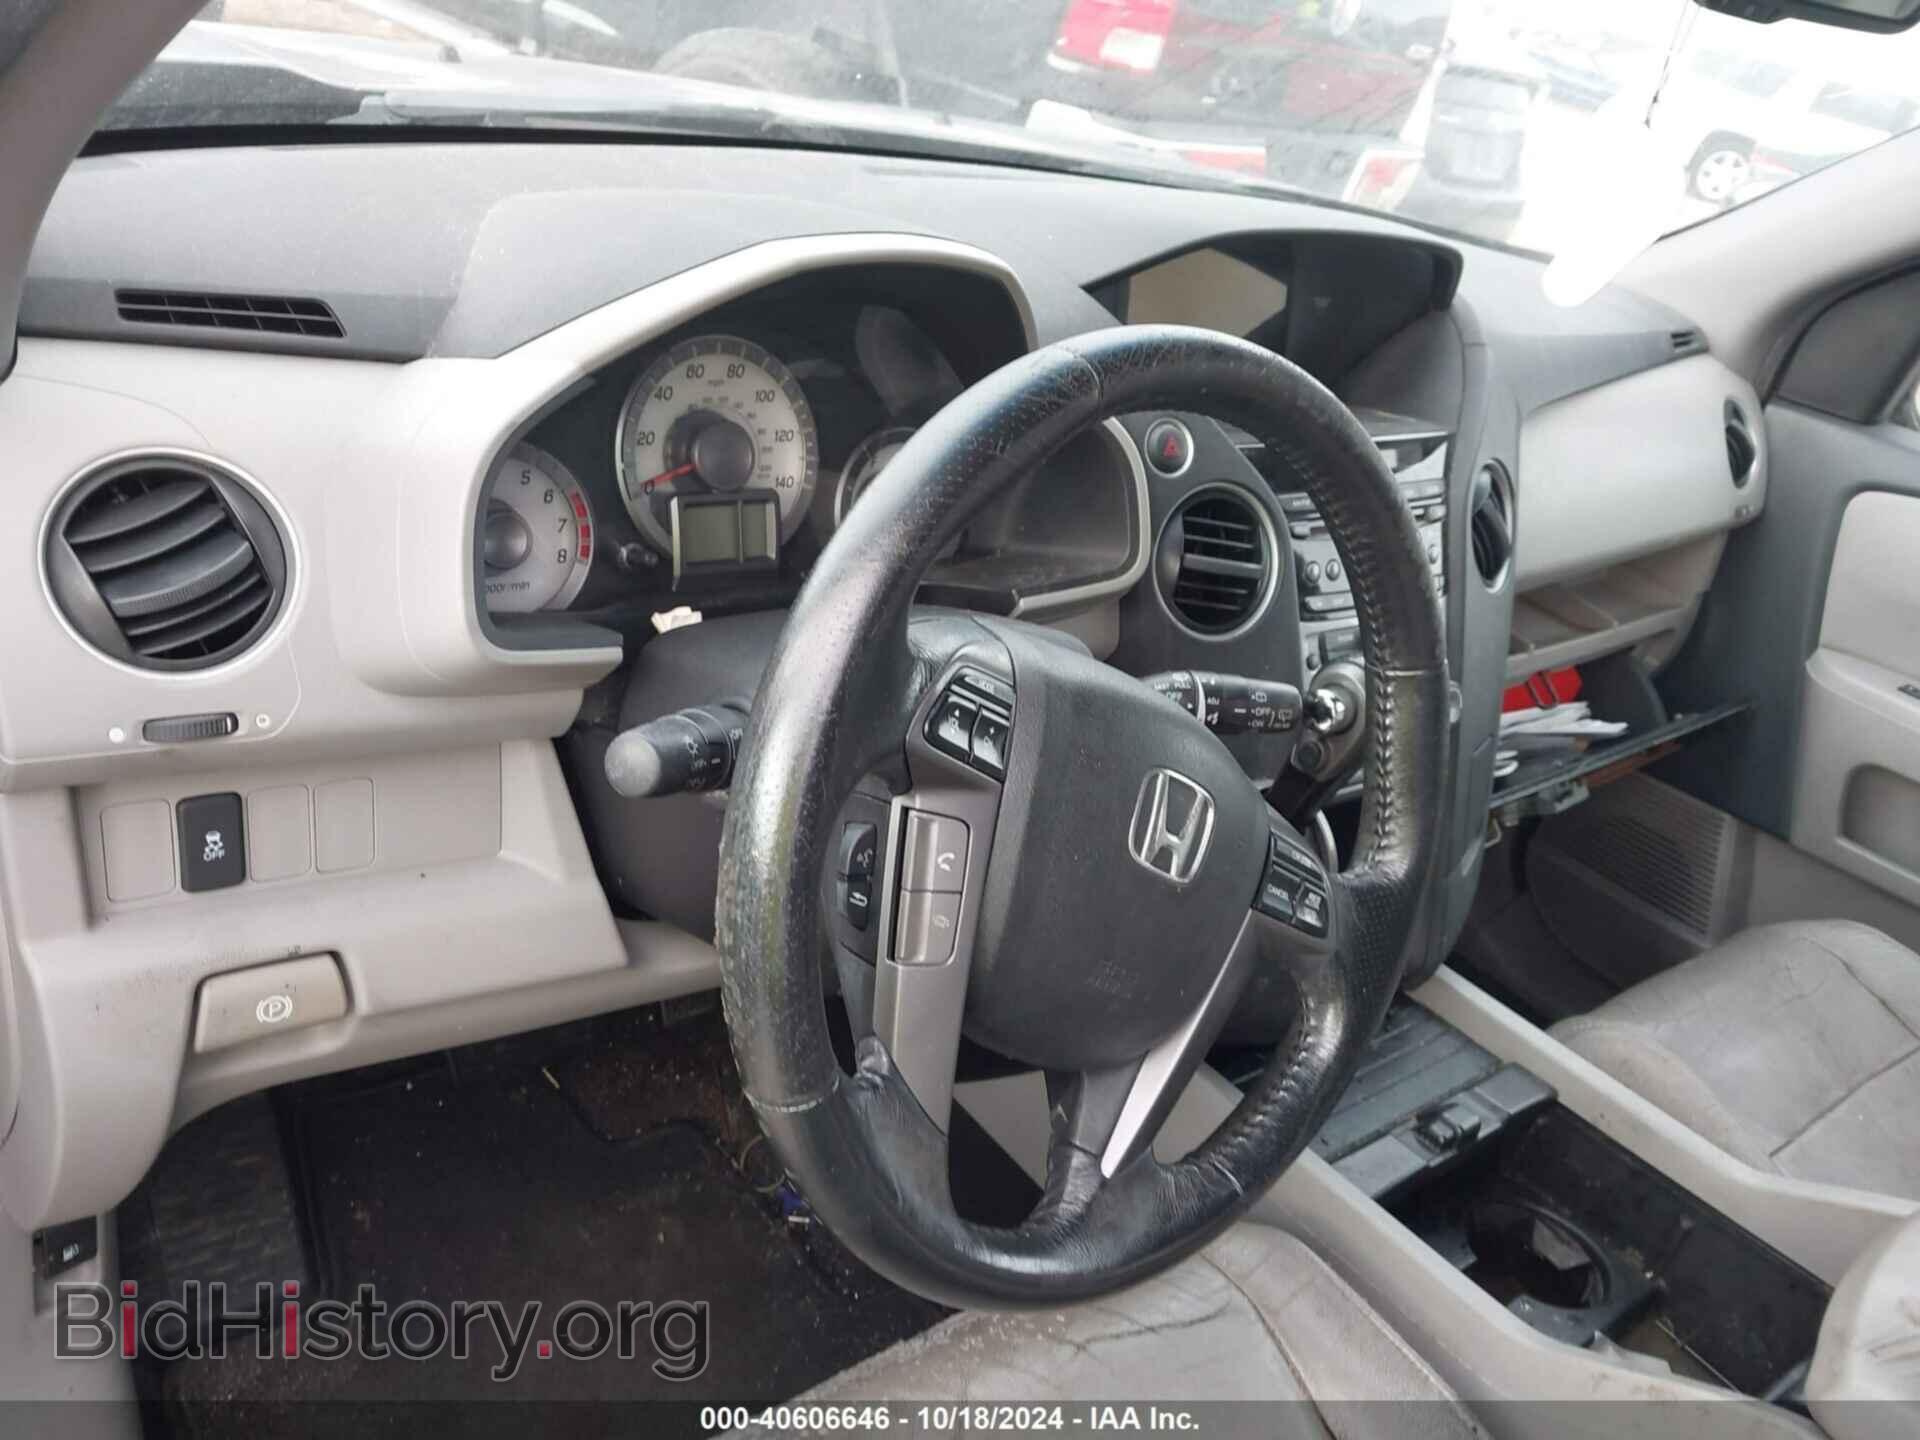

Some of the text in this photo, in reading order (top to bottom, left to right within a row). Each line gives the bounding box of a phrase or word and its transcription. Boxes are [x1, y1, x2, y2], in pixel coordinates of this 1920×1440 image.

[727, 364, 746, 379] 80
[654, 386, 673, 401] 40
[755, 389, 776, 402] 100
[637, 431, 655, 446] 20
[775, 429, 794, 442] 120
[520, 471, 531, 487] 5
[775, 475, 794, 489] 140
[543, 489, 554, 505] 6
[557, 518, 568, 532] 7
[557, 549, 568, 563] 8
[203, 849, 225, 861] OFF
